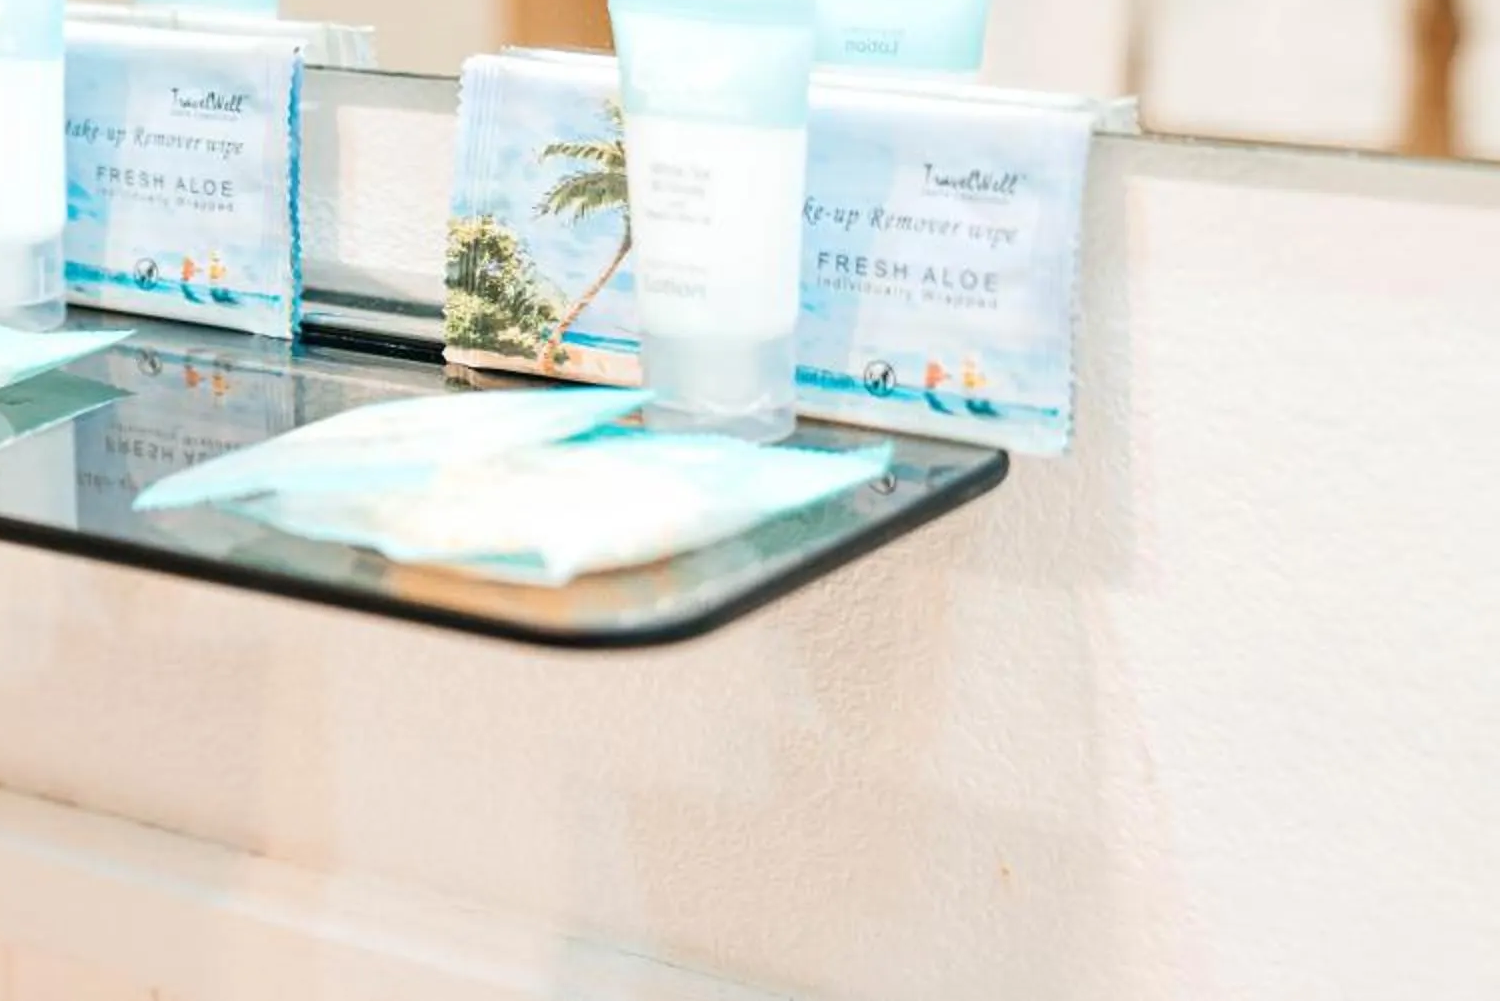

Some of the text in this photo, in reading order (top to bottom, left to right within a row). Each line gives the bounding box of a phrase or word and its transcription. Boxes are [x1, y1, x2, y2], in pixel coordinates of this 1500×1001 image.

[95, 165, 165, 190] FRESH
[175, 175, 234, 198] ALOE
[801, 195, 860, 231] ke-up
[869, 204, 961, 236] Remover
[816, 251, 999, 293] FRESH ALOE
